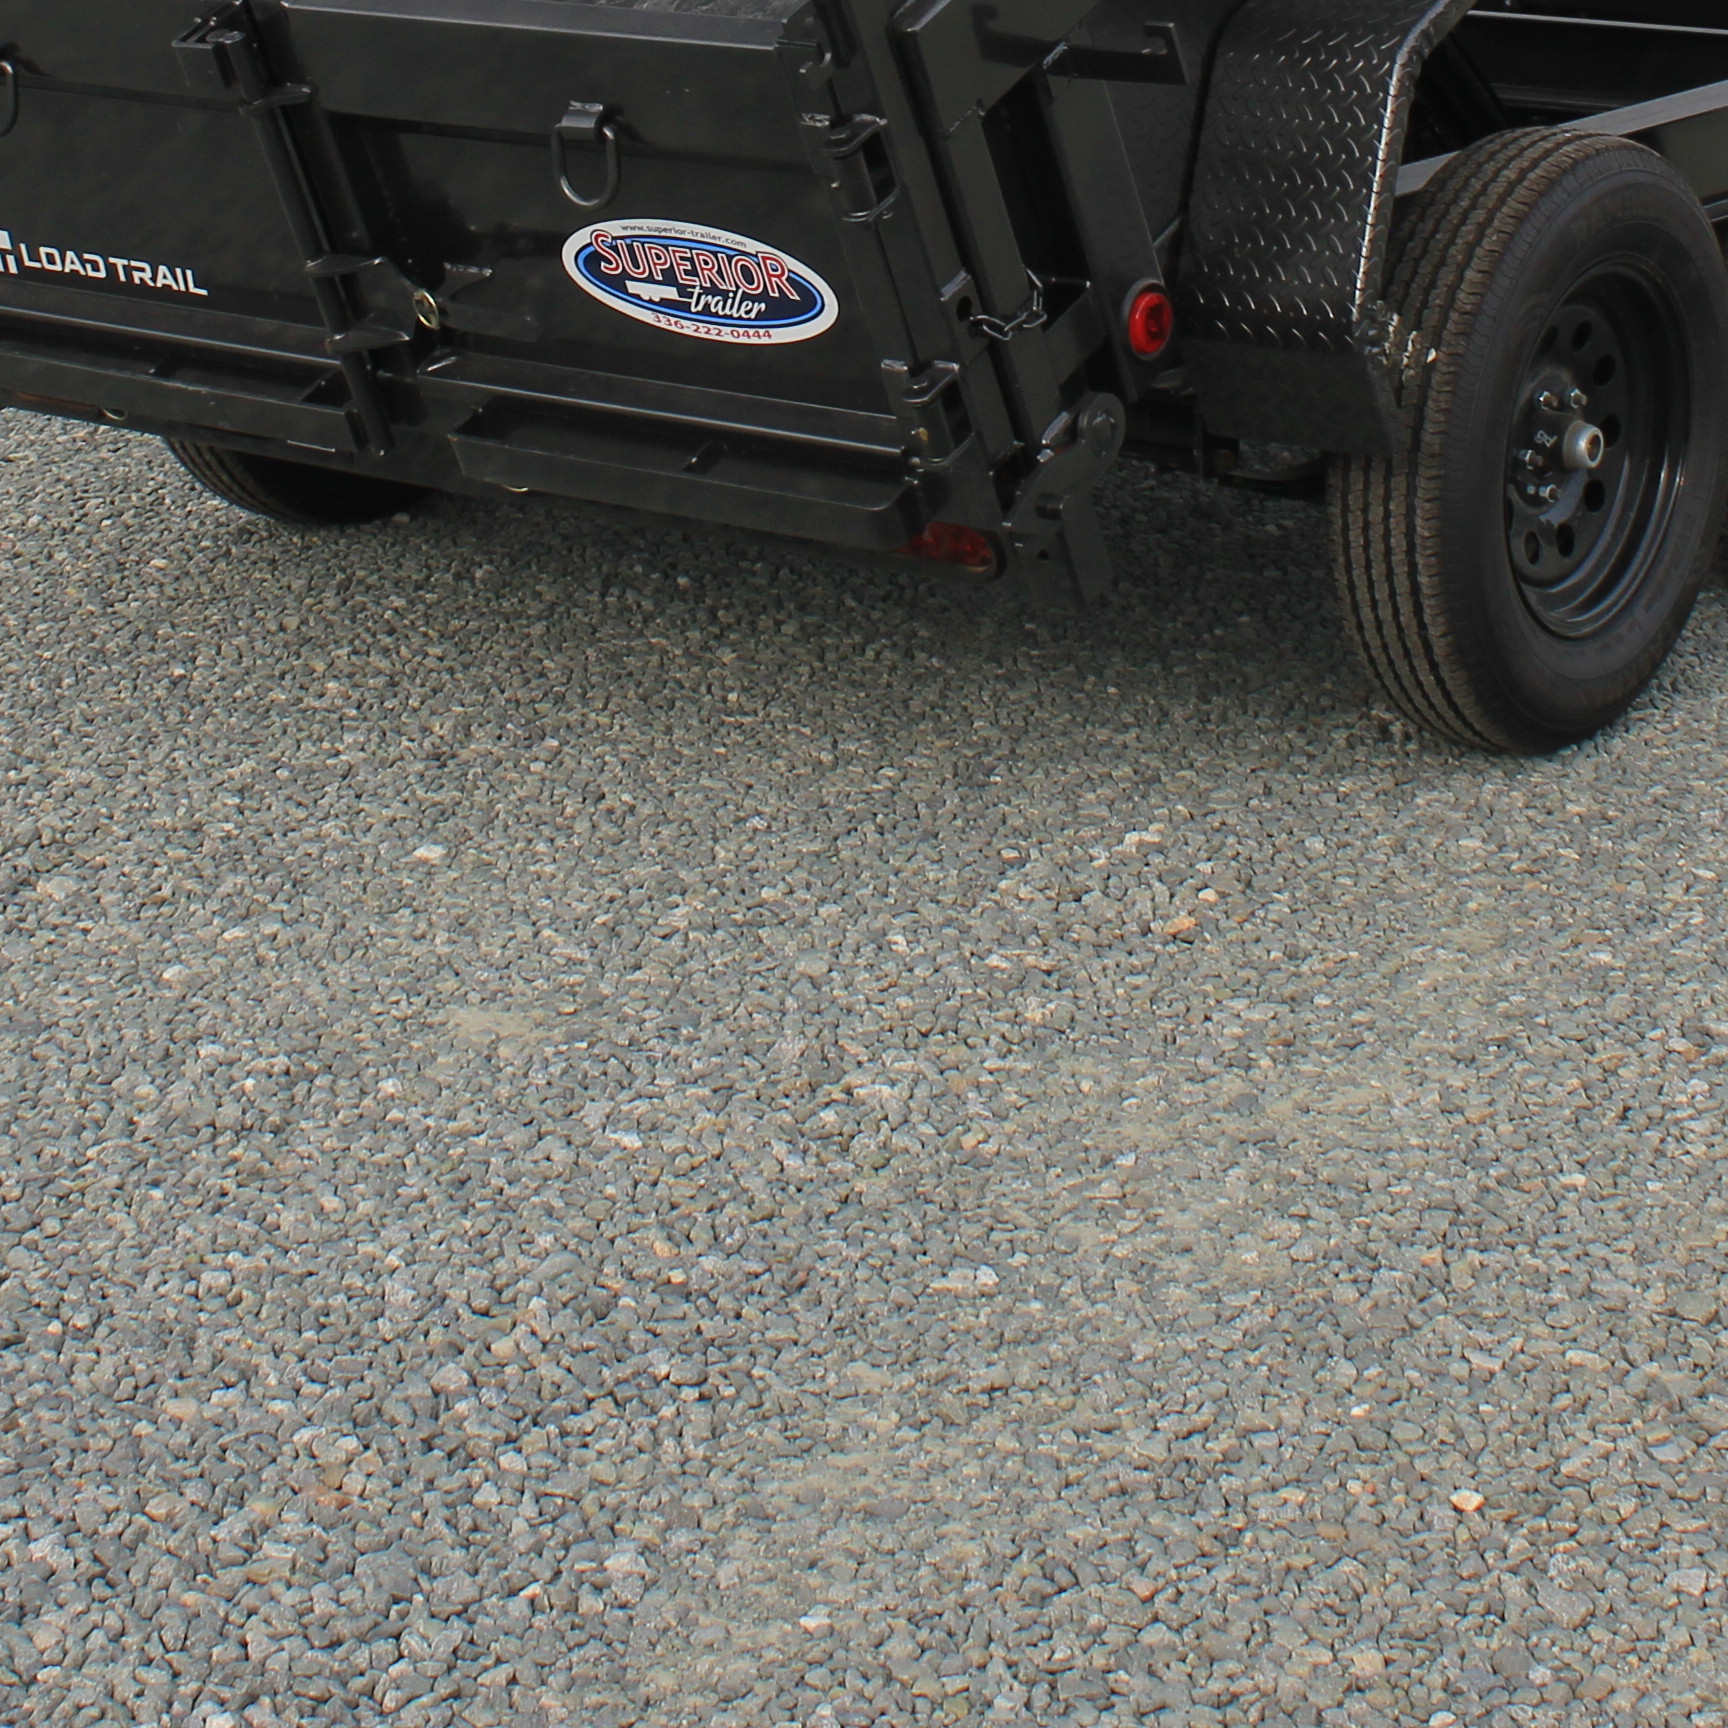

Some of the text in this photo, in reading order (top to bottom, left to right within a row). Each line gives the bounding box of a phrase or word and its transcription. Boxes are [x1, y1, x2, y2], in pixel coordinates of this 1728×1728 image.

[620, 224, 747, 249] www.superior-trailer.com
[591, 229, 801, 301] SUPERIOR
[686, 284, 767, 320] trailer
[650, 311, 773, 340] 336-222-0444
